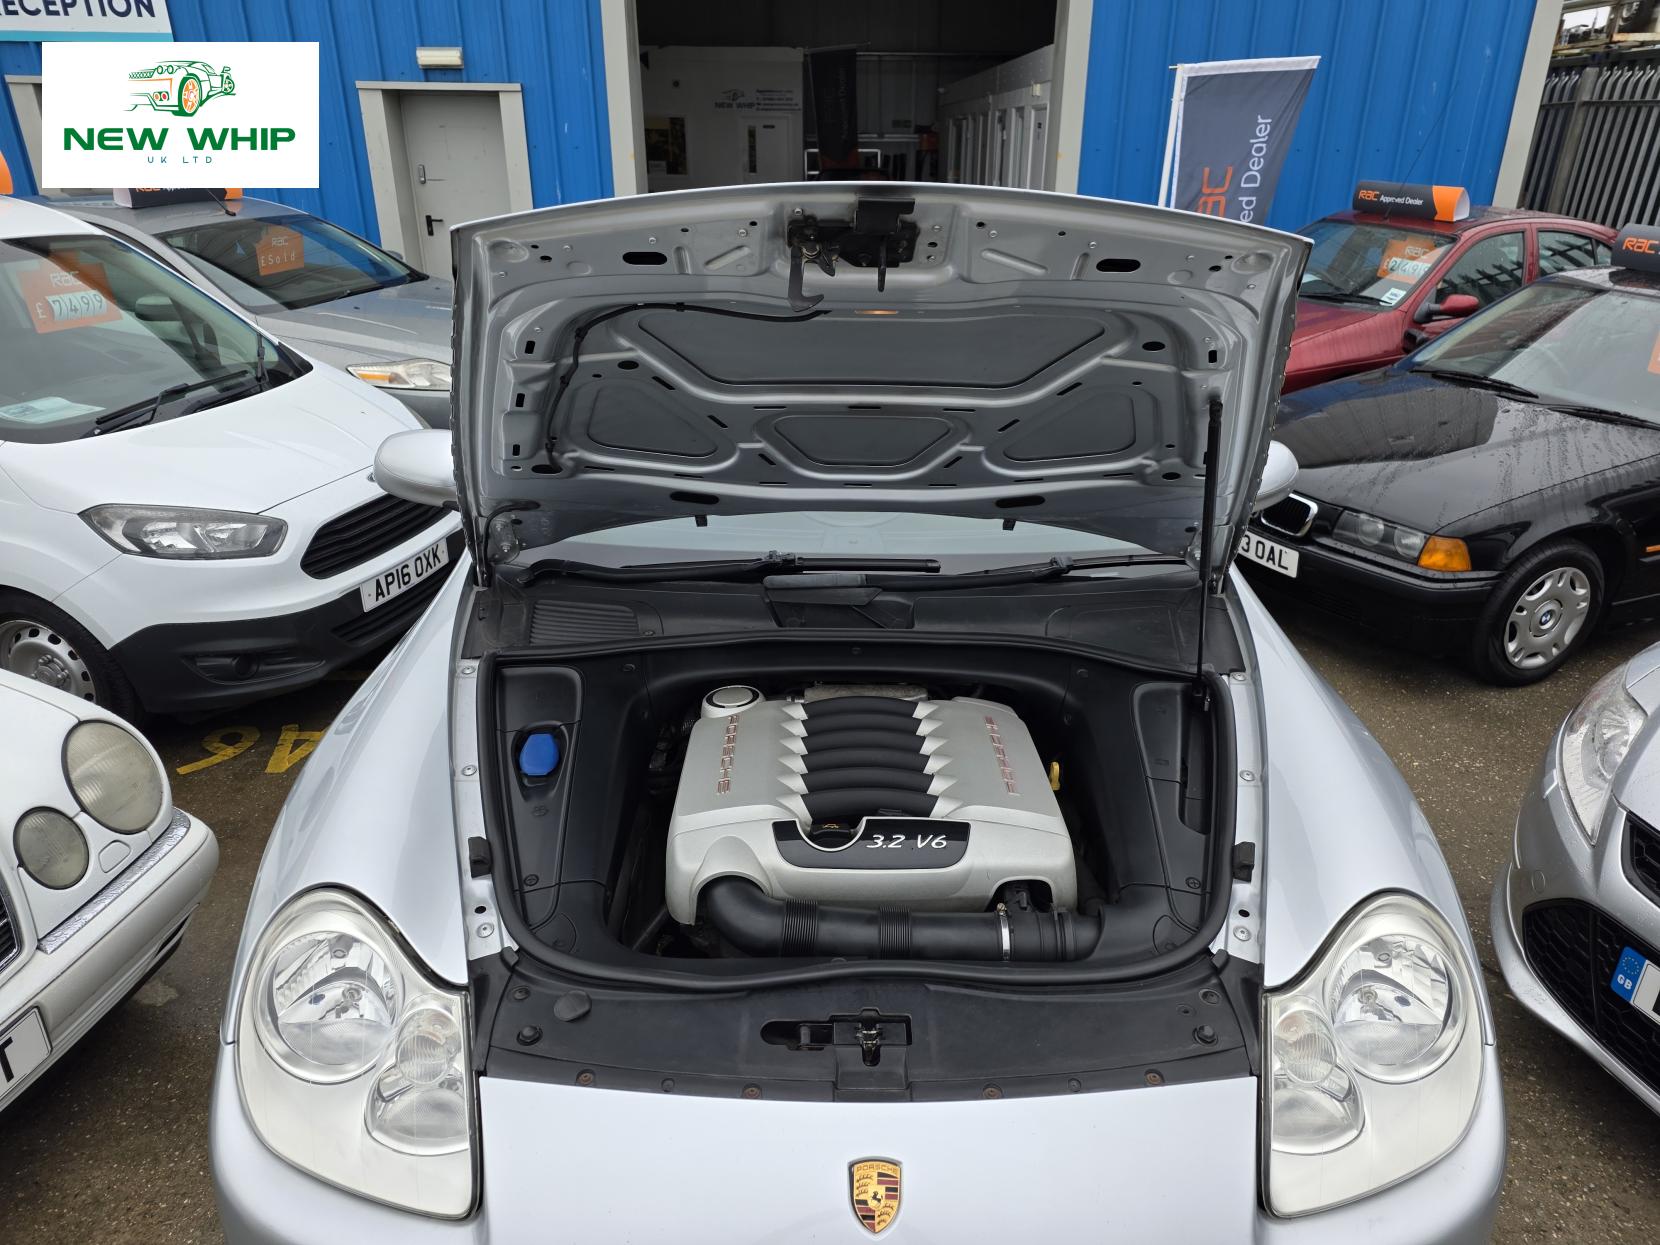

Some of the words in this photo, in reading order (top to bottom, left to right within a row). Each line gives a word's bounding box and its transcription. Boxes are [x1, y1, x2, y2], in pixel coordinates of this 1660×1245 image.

[0, 0, 155, 17] ECEPTION
[1240, 115, 1272, 188] Dealer
[1195, 166, 1233, 219] AC
[1359, 190, 1379, 200] RAC
[1380, 194, 1405, 204] Approved
[1405, 196, 1423, 206] Dealer
[1623, 236, 1659, 254] RAC
[375, 563, 412, 602] AP16
[866, 834, 906, 848] 3.2
[917, 834, 947, 848] V6
[1617, 974, 1633, 990] GB
[856, 1163, 897, 1174] PORSCHE
